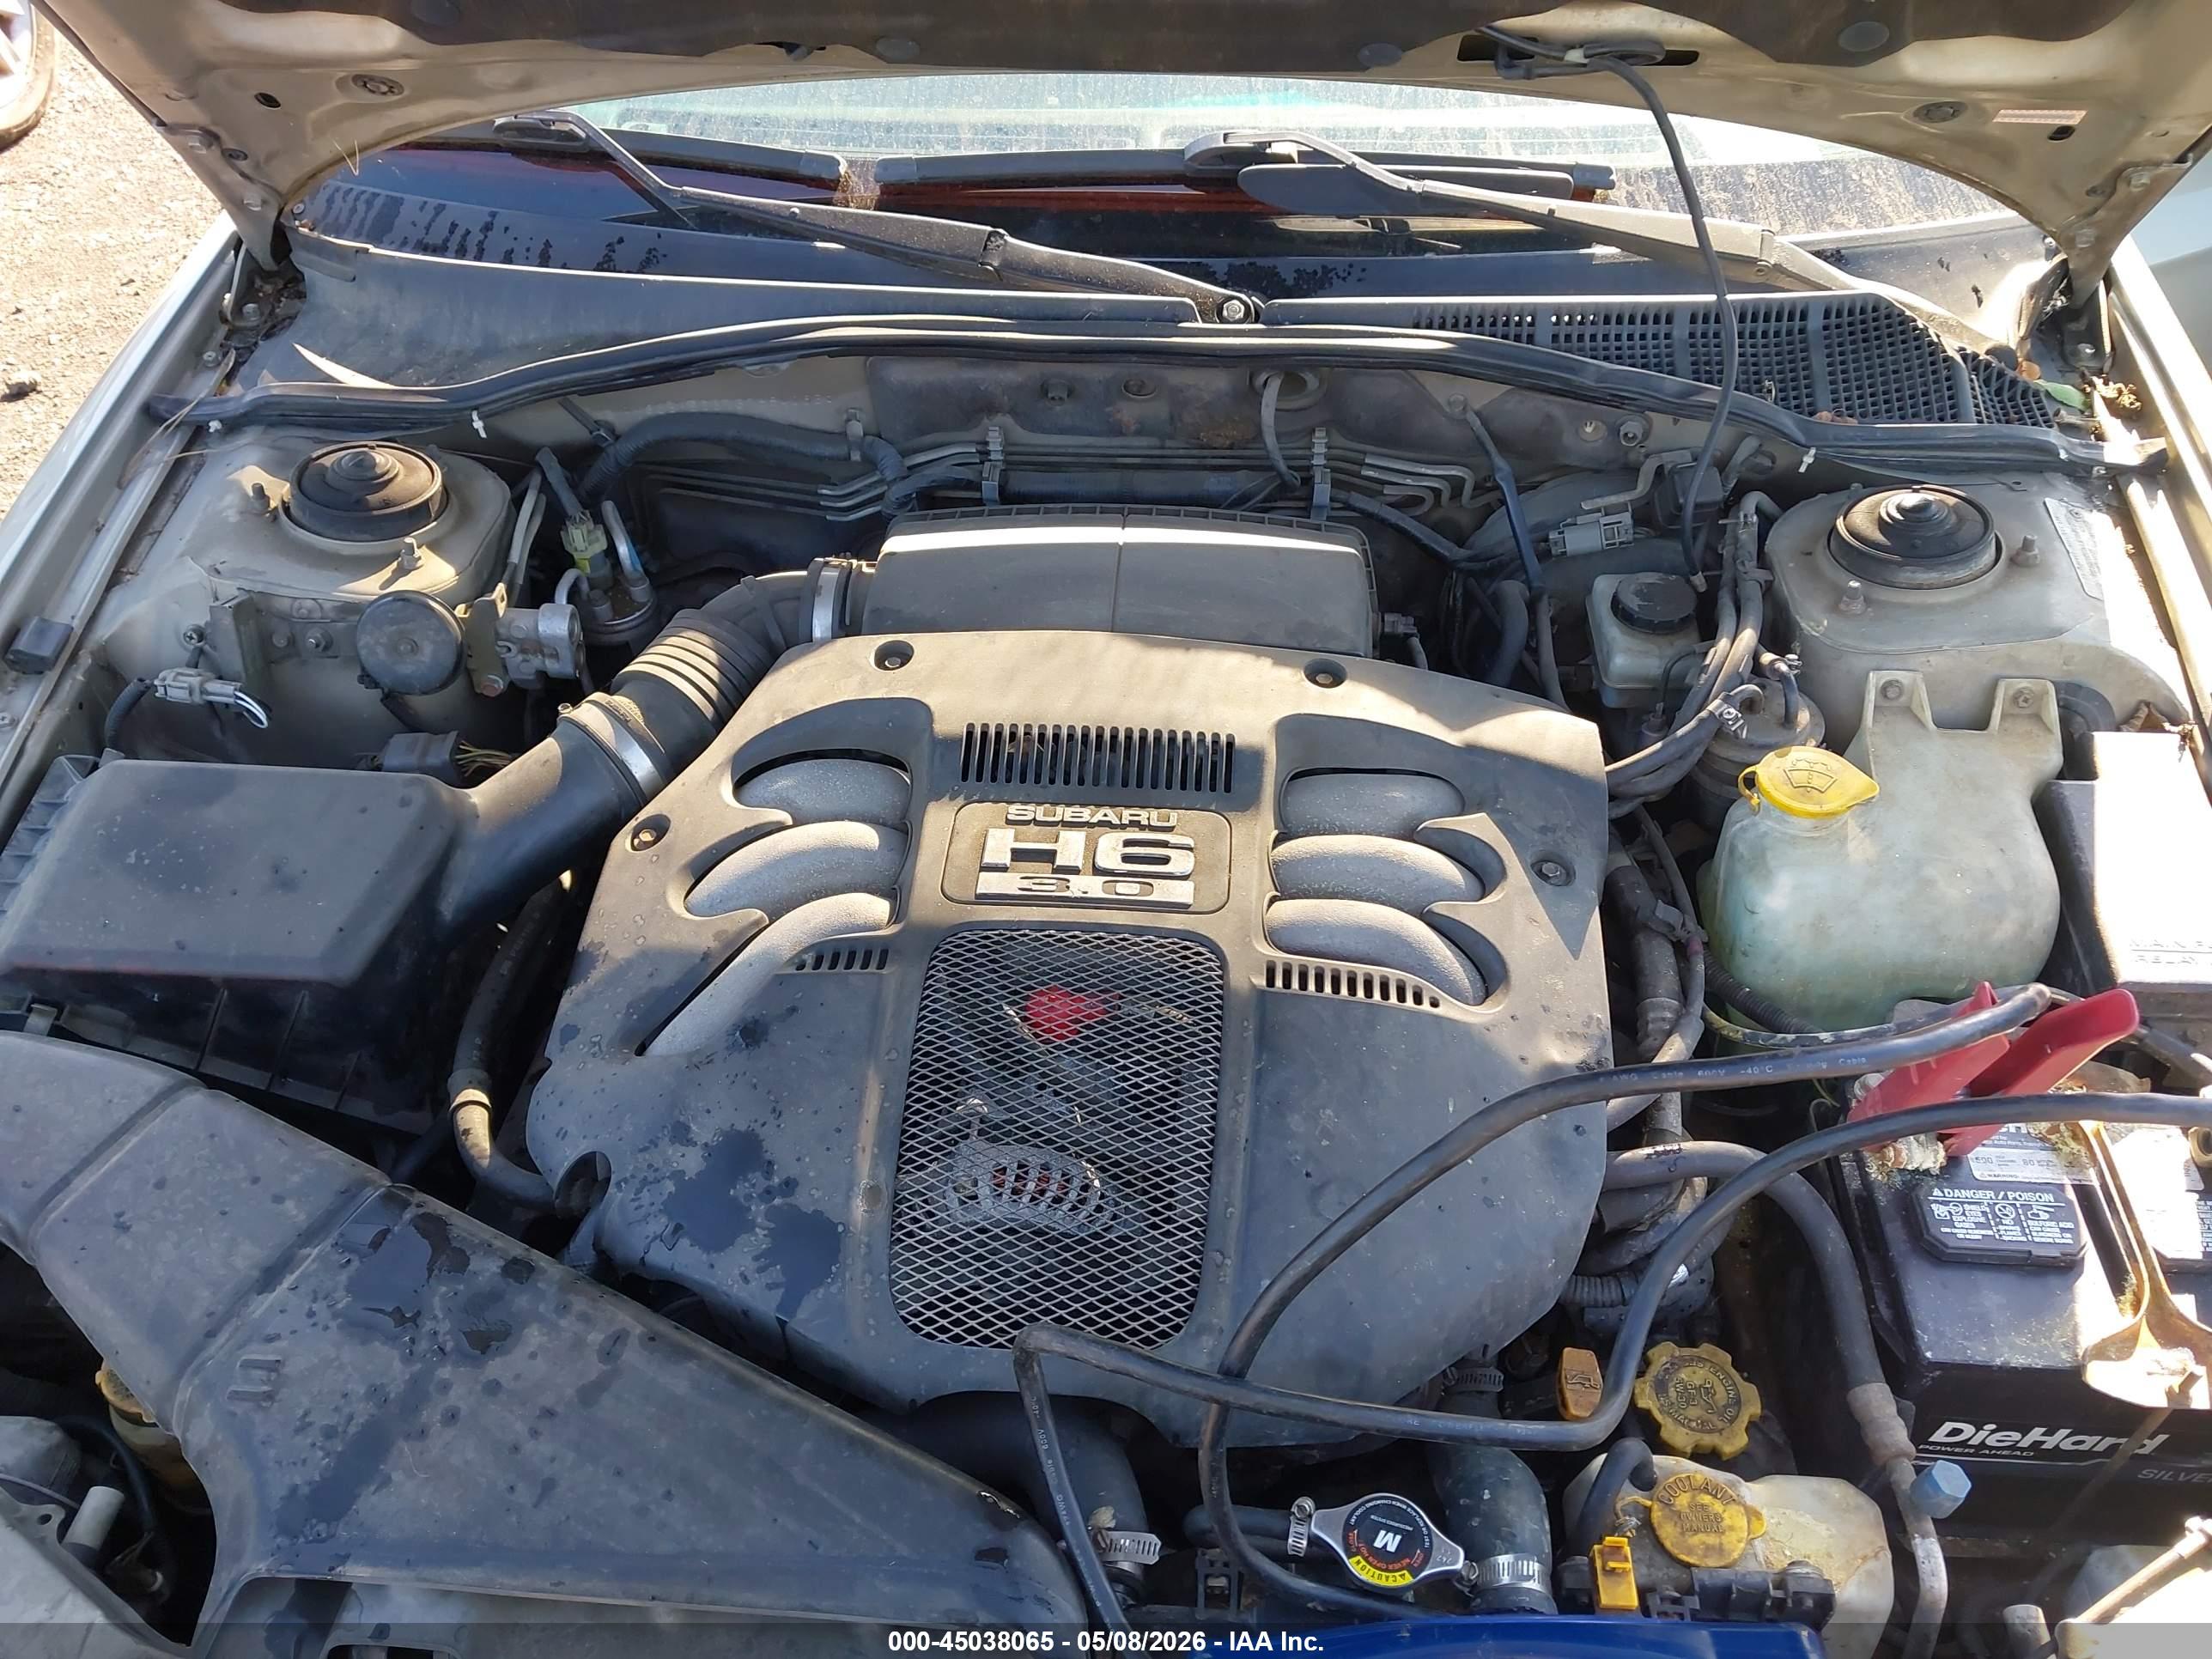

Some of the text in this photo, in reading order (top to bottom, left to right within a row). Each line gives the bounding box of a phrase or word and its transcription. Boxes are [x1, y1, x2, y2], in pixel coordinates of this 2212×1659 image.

[1006, 805, 1177, 829] SUBARU
[981, 828, 1195, 877] H6
[1017, 875, 1154, 896] 3.0
[1943, 1188, 1996, 1200] DANGER
[2007, 1191, 2055, 1202] POISON
[1710, 1366, 1737, 1423] ENGINE OIL
[1918, 1444, 1975, 1454] POWER
[1928, 1421, 2171, 1455] DieHard
[2137, 1469, 2212, 1484] SILVE
[1657, 1474, 1738, 1505] COOLANT
[1349, 1505, 1366, 1526] COOLANT
[1689, 1503, 1710, 1511] SEE
[1682, 1522, 1725, 1533] MANUAL
[1373, 1529, 1402, 1553] M
[1354, 1559, 1397, 1583] CAUTION
